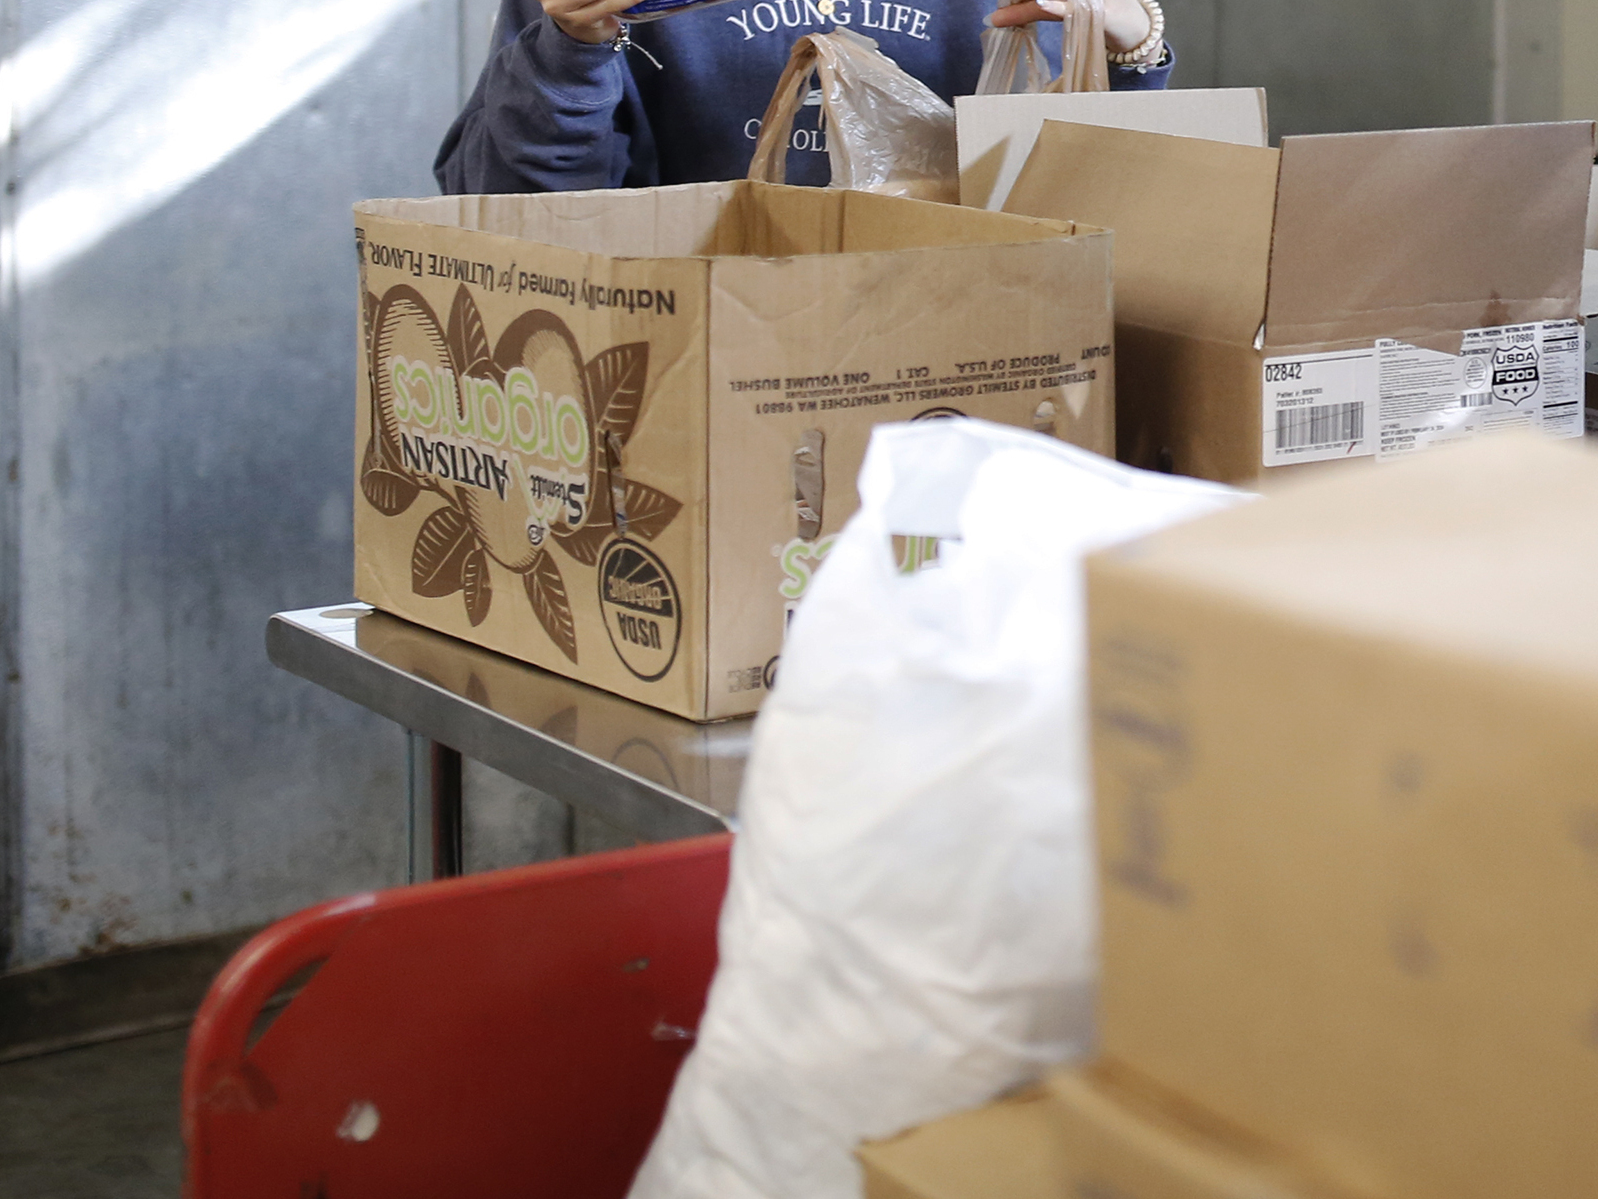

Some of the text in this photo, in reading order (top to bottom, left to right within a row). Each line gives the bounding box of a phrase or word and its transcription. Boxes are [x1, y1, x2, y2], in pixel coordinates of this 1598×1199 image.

[861, 0, 931, 40] LIFE
[427, 253, 495, 291] ULTIMATE
[497, 260, 516, 294] for
[518, 271, 575, 306] Farmed
[582, 276, 676, 315] Naturally
[1009, 354, 1060, 369] PRODUCE
[1495, 351, 1535, 365] USDA
[991, 360, 1006, 372] OF
[1265, 364, 1302, 382] 02842
[843, 372, 870, 385] ONE
[896, 369, 902, 380] 1
[1041, 370, 1096, 388] DISTRIBUTED
[1495, 369, 1535, 383] FOOD
[729, 378, 781, 393] BUSHEL
[785, 375, 840, 390] VOLUME
[976, 380, 1020, 395] STEMILT
[1023, 379, 1036, 389] BY
[919, 385, 974, 400] GROWERS
[755, 402, 793, 414] 98801
[798, 401, 817, 412] WA
[820, 393, 891, 410] WENATCHEE
[393, 363, 586, 464] organics
[401, 433, 586, 525] Stemilt ARTISAN
[608, 575, 662, 610] ORGANIC
[617, 612, 662, 650] USDA
